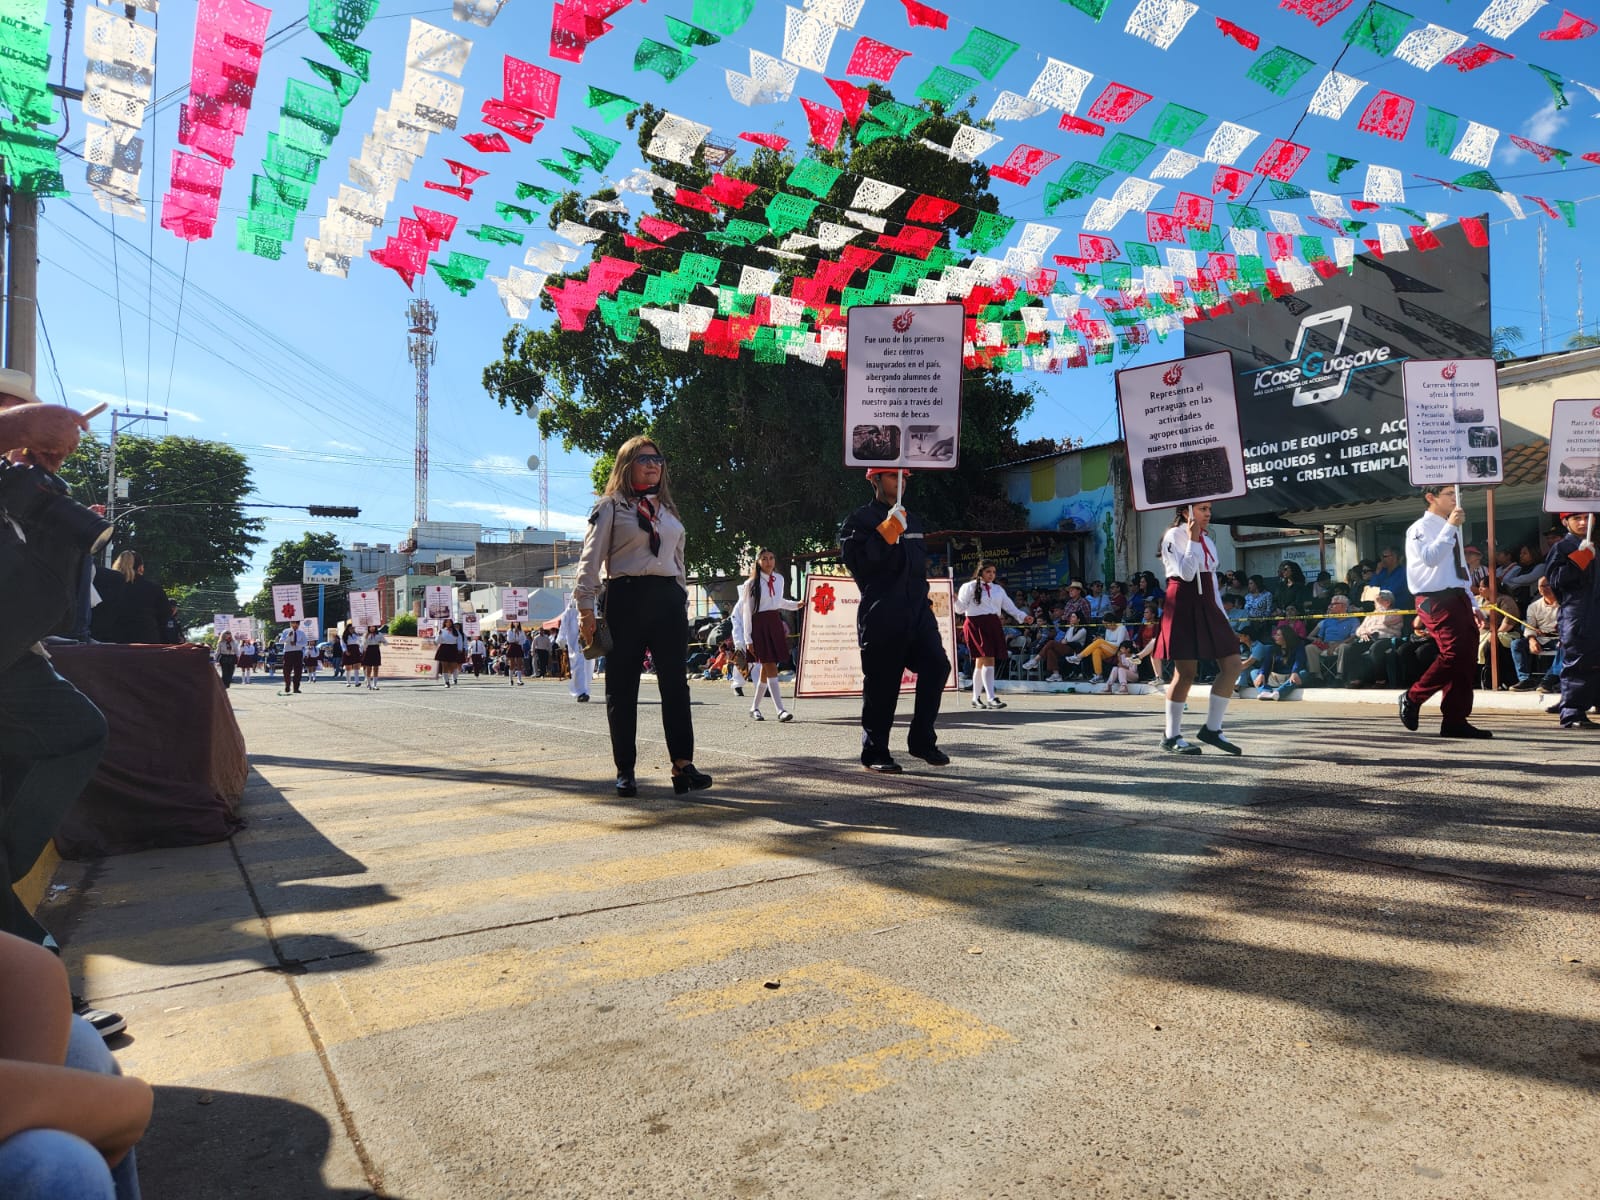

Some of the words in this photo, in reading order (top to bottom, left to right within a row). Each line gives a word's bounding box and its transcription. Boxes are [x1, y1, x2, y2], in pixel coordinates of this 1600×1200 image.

[865, 335, 876, 343] Fue
[893, 335, 900, 343] de
[903, 335, 912, 343] los
[915, 335, 944, 345] primeros
[884, 348, 897, 356] diez
[899, 348, 924, 356] centros
[866, 360, 906, 370] inaugurados
[918, 360, 924, 368] el
[866, 373, 901, 382] albergando
[903, 373, 930, 381] alumnos
[876, 385, 896, 395] región
[1150, 386, 1194, 401] Representa
[1196, 383, 1204, 392] el
[862, 398, 887, 406] nuestro
[910, 398, 930, 406] través
[933, 398, 943, 406] del
[1144, 402, 1187, 416] parteaguas
[1190, 399, 1199, 407] en
[1201, 396, 1213, 405] las
[901, 410, 909, 418] de
[911, 410, 929, 418] becas
[1158, 412, 1202, 425] actividades
[1149, 425, 1203, 441] agropecuarias
[1205, 422, 1214, 430] de
[1148, 444, 1177, 453] nuestro
[1180, 435, 1220, 448] municipio.
[1282, 439, 1297, 451] DE
[1301, 428, 1358, 448] EQUIPOS
[1297, 466, 1348, 483] CRISTAL
